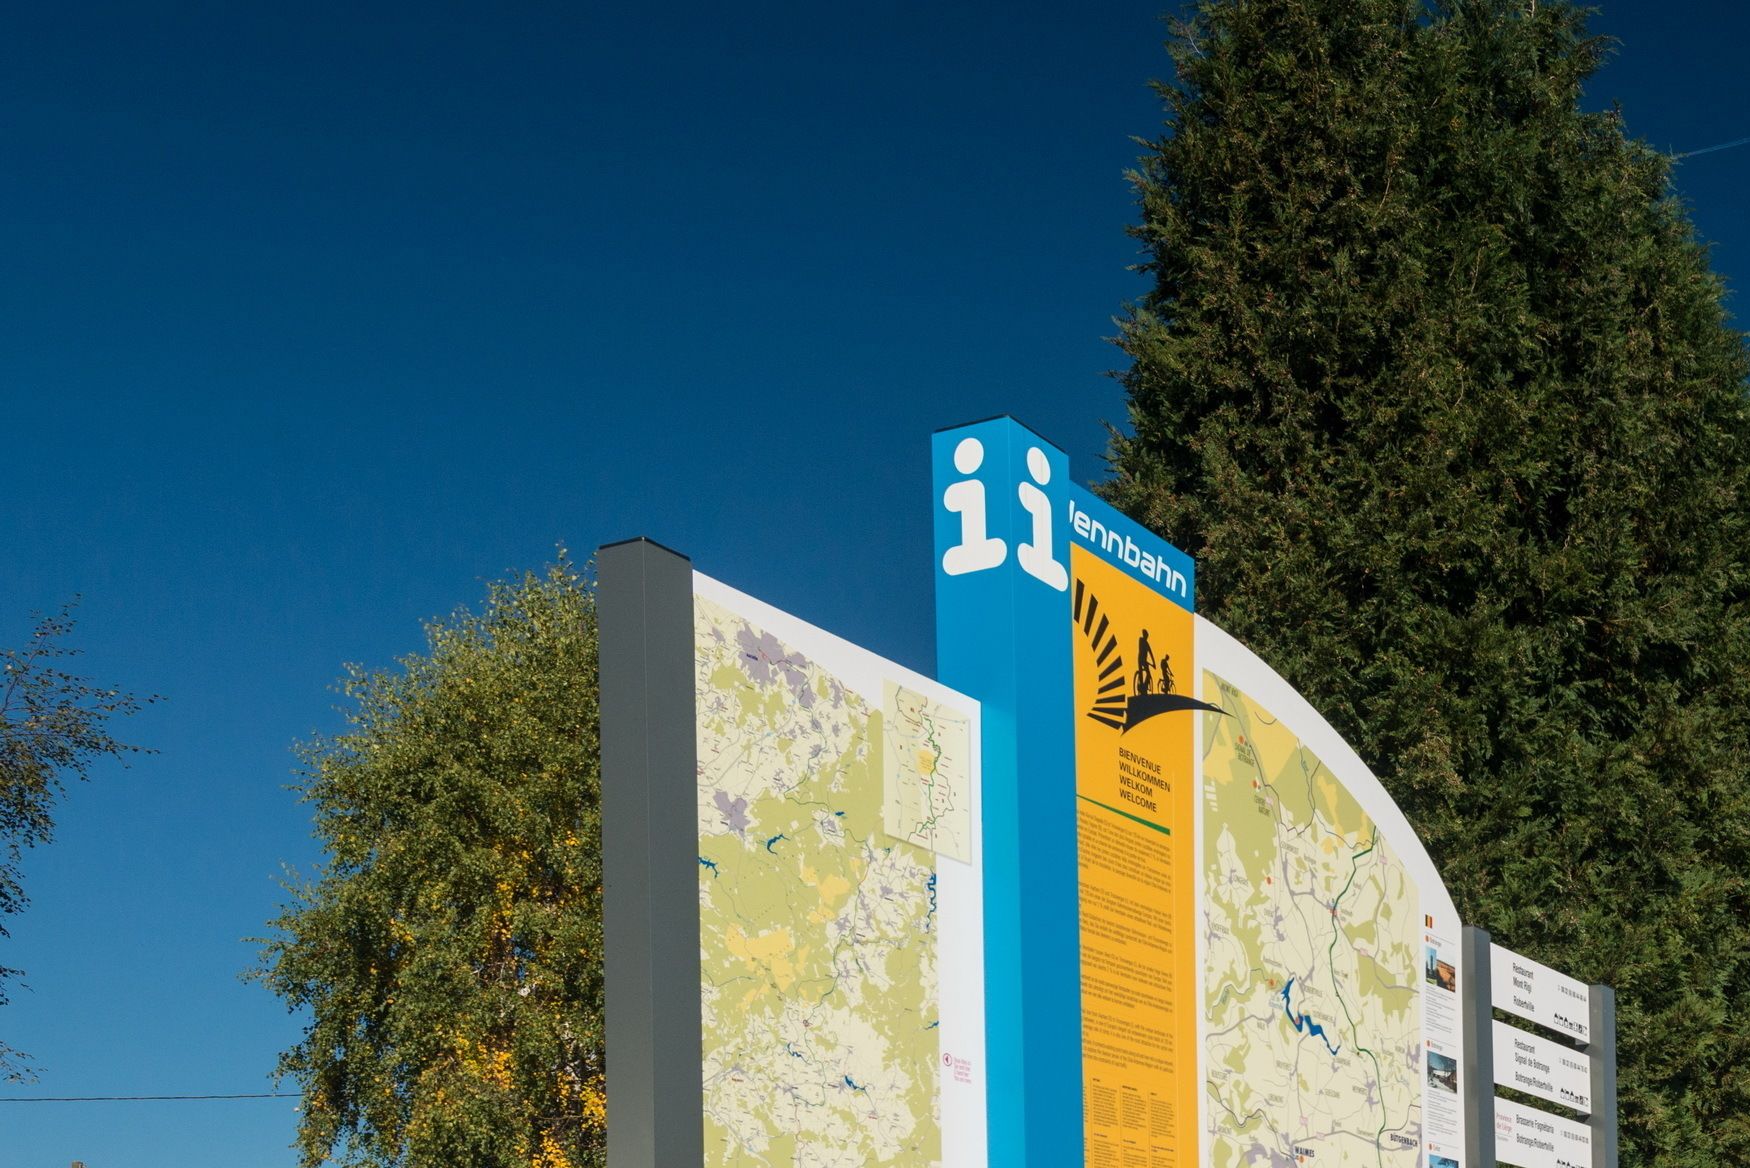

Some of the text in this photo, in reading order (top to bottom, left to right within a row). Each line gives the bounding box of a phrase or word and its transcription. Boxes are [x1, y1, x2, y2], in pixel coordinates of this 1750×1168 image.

[1119, 747, 1161, 775] BIENVENUE
[1119, 760, 1171, 793] WILLKOMMEN
[1119, 774, 1153, 798] WELKOM
[1119, 788, 1157, 813] WELCOME
[1512, 962, 1533, 979] Restaurant
[1512, 976, 1522, 989] Mont
[1514, 1038, 1534, 1054] Restaurant
[1533, 1058, 1549, 1075] Botrange
[1390, 1133, 1418, 1147] BÜTGENBACH
[1295, 1146, 1315, 1158] WAIMES
